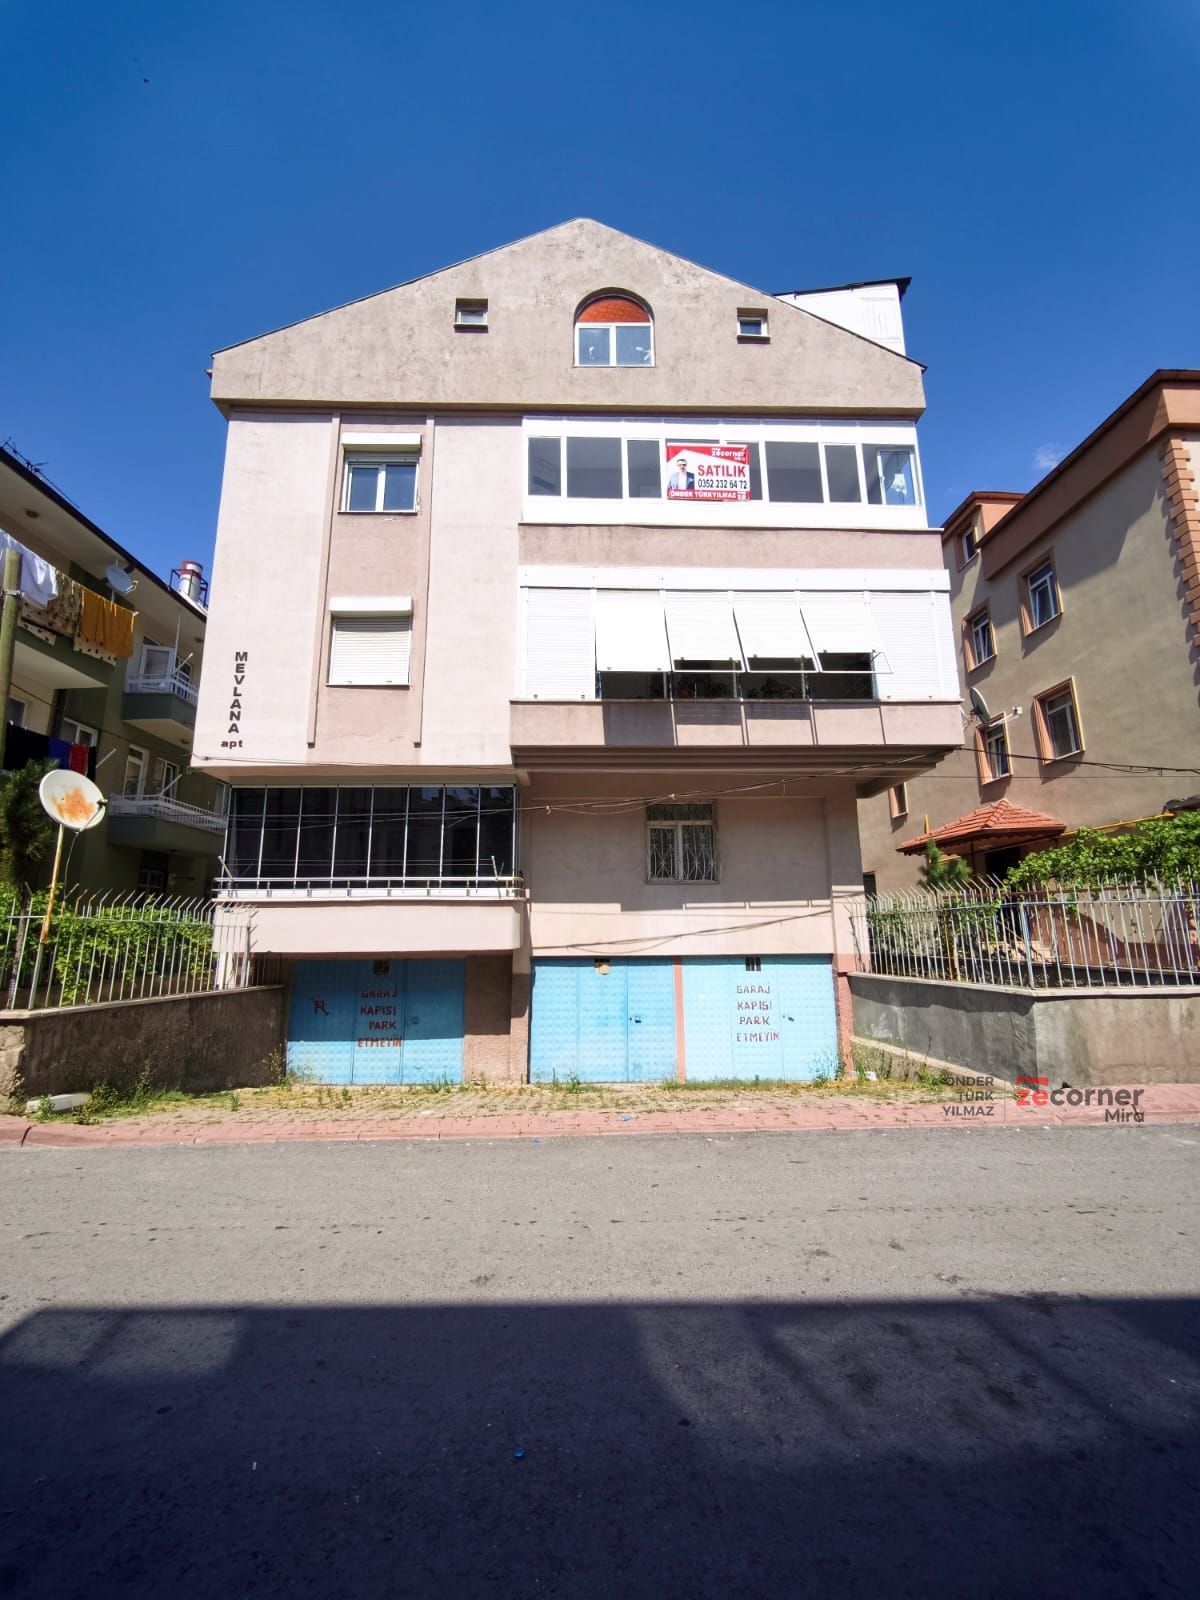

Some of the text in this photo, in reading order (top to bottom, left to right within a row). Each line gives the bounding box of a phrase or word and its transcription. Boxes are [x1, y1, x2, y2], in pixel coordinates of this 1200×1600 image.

[697, 464, 746, 477] SATILIK
[698, 479, 747, 489] 0352 232 64 72
[228, 651, 248, 733] MEVLANA
[221, 740, 243, 749] apt
[361, 986, 397, 998] GARAJ
[736, 982, 771, 994] GARAJ
[737, 1000, 772, 1010] KAPISI
[360, 1005, 396, 1016] KAPISI
[368, 1020, 397, 1030] PARK
[739, 1016, 770, 1025] PARK
